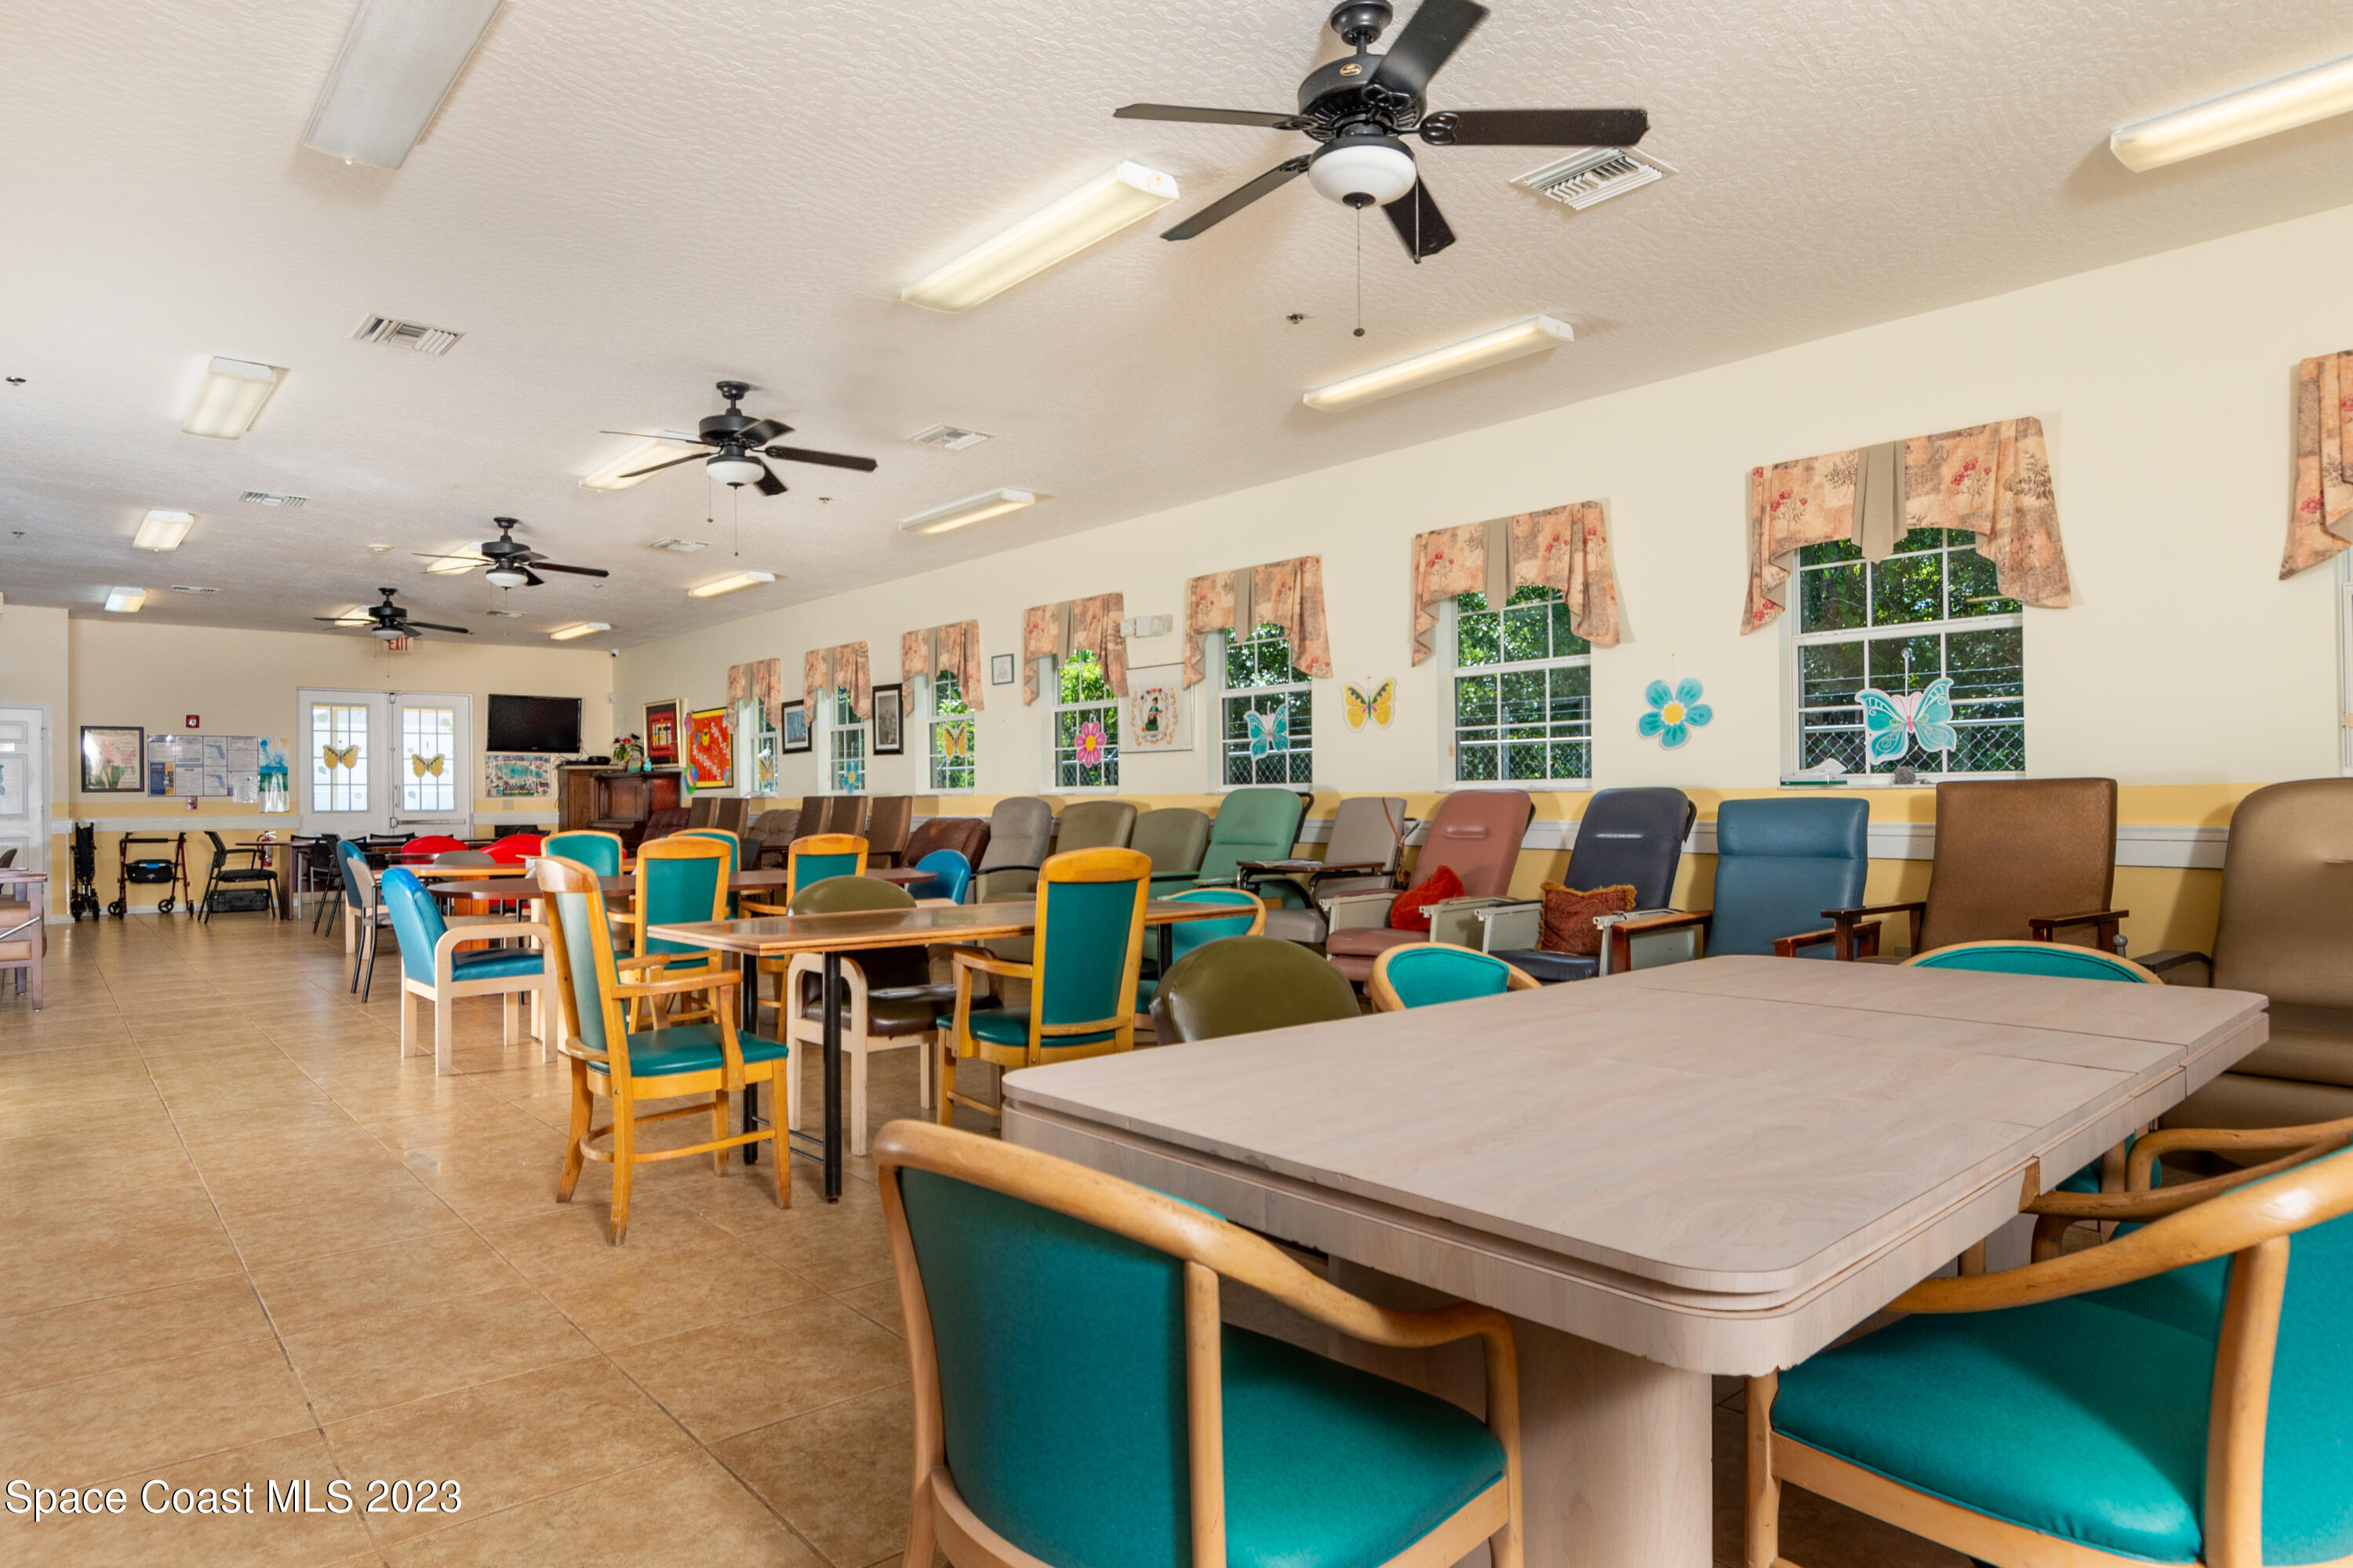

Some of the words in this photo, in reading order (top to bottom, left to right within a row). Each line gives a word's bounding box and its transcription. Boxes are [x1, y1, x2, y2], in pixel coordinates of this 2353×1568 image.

[389, 637, 409, 651] EXIT
[711, 722, 729, 759] SMILES
[693, 744, 721, 780] SUNSHINE
